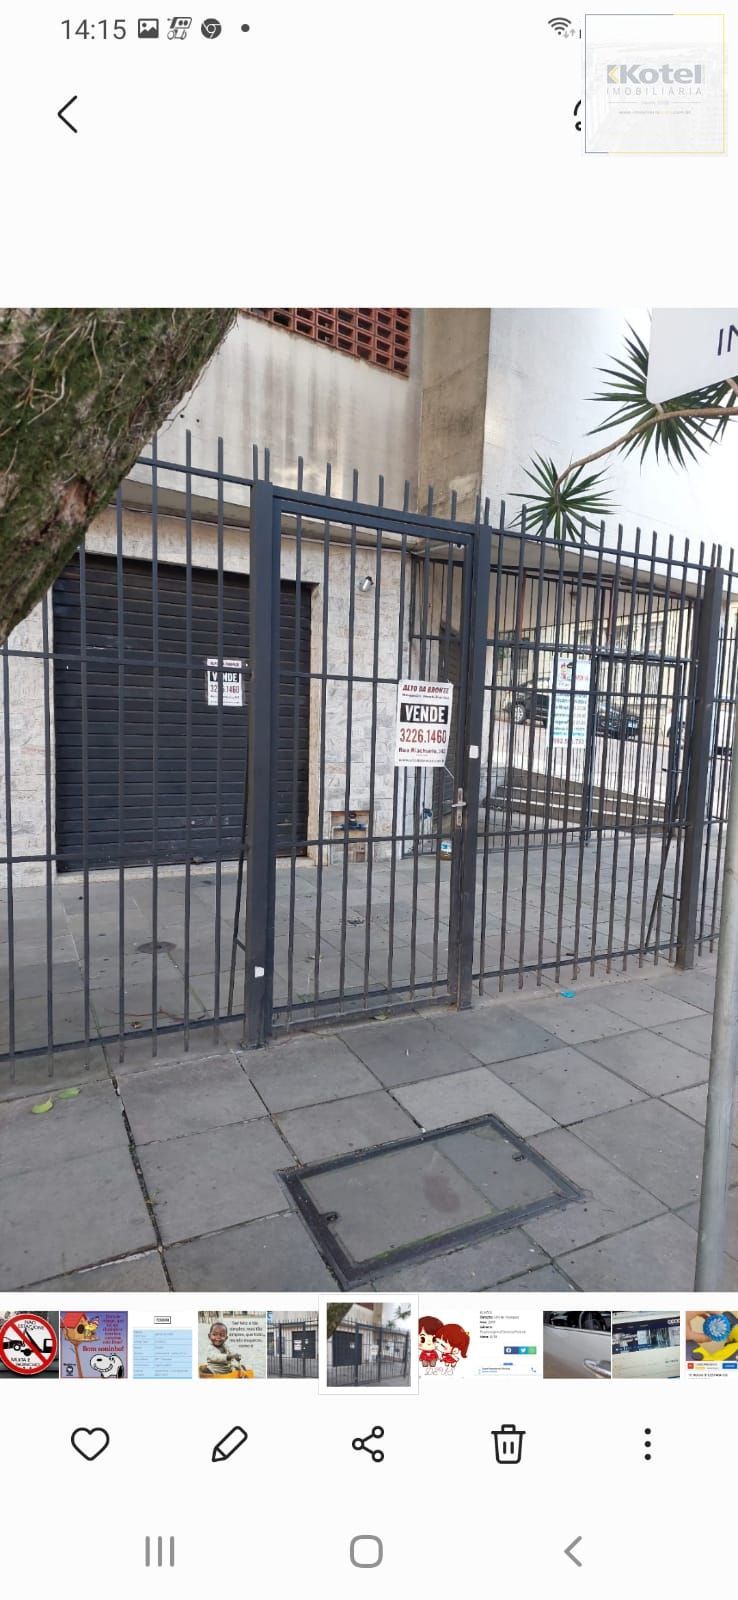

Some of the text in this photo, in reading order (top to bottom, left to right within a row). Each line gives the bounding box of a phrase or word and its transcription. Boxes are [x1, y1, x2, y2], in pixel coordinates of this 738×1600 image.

[61, 19, 126, 40] 14:15
[212, 672, 238, 682] VNDE
[405, 705, 445, 722] VENDE
[400, 728, 447, 743] 3226.1460
